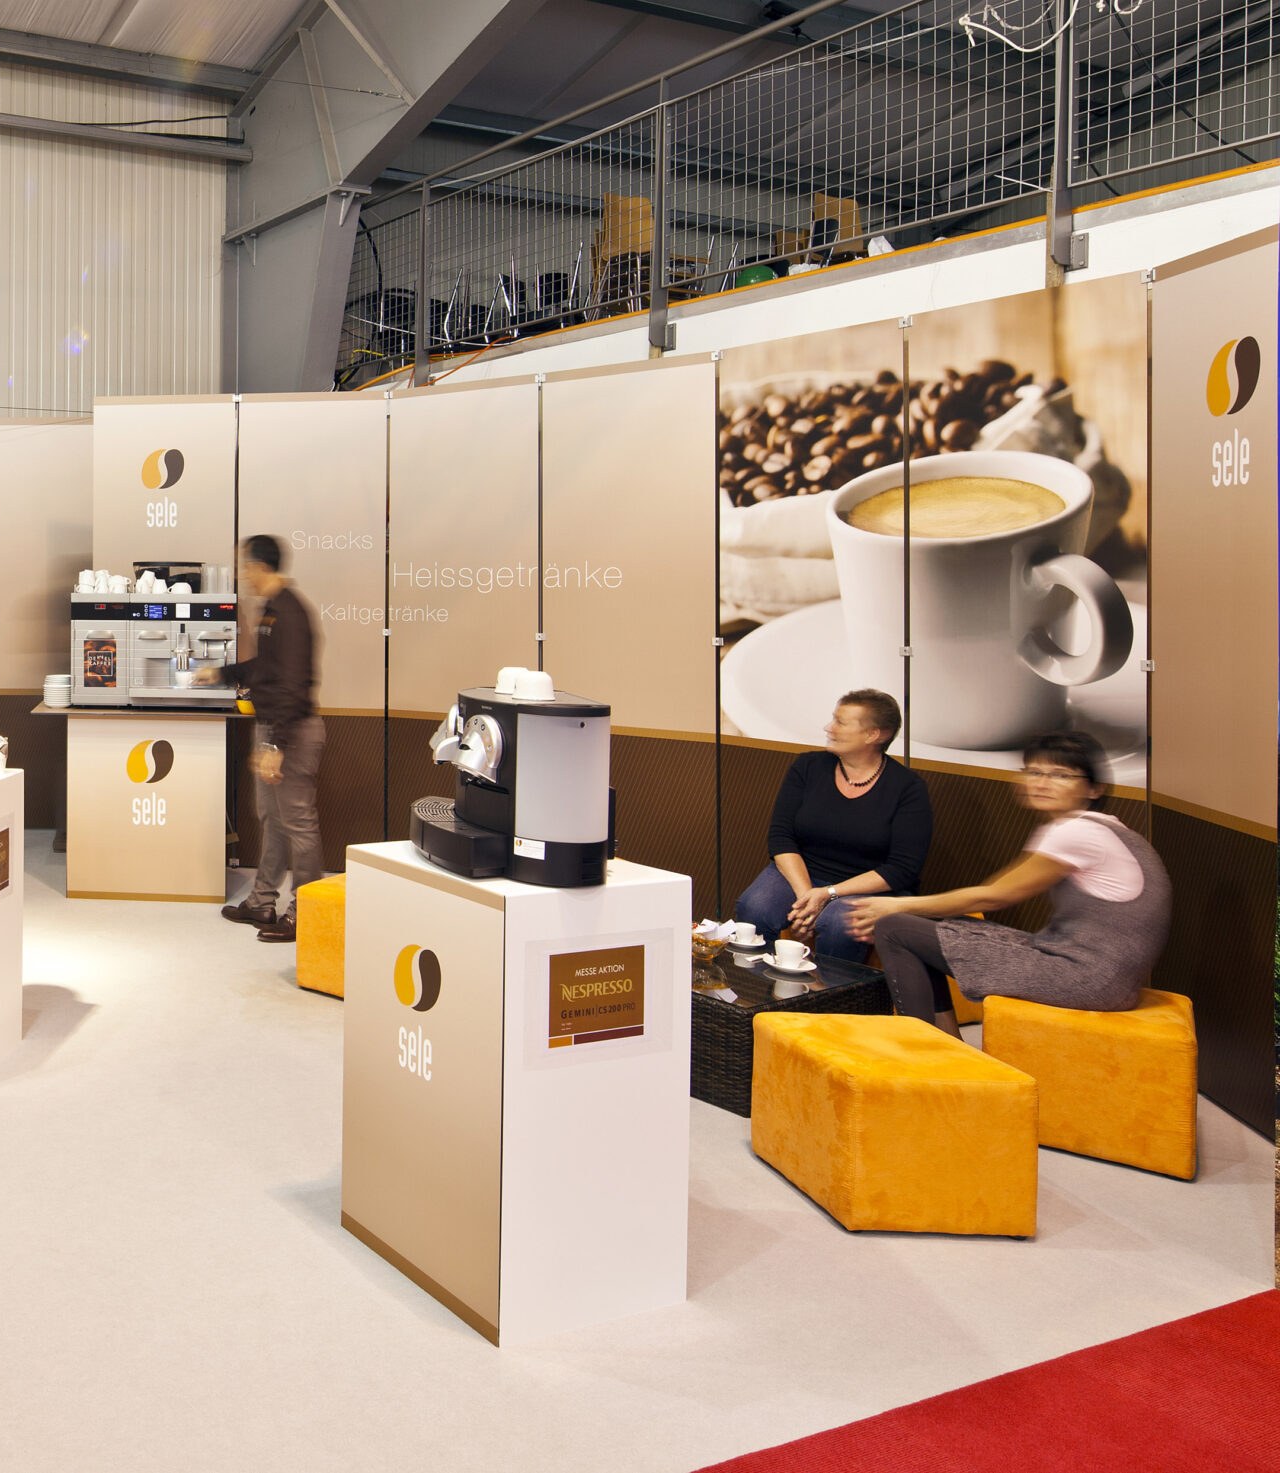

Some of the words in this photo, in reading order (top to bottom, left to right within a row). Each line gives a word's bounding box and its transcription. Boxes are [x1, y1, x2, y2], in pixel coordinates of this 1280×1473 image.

[1212, 428, 1250, 487] sele
[146, 496, 177, 528] sele
[291, 530, 373, 550] Snacks
[393, 560, 623, 594] Heissgetränke
[320, 603, 449, 625] Kaltgetränke
[132, 791, 167, 826] sele
[575, 967, 597, 977] MESSE
[598, 964, 625, 975] AKTION
[560, 978, 634, 1003] NESPRESSO
[622, 1001, 636, 1012] PRO
[398, 1025, 433, 1081] sele
